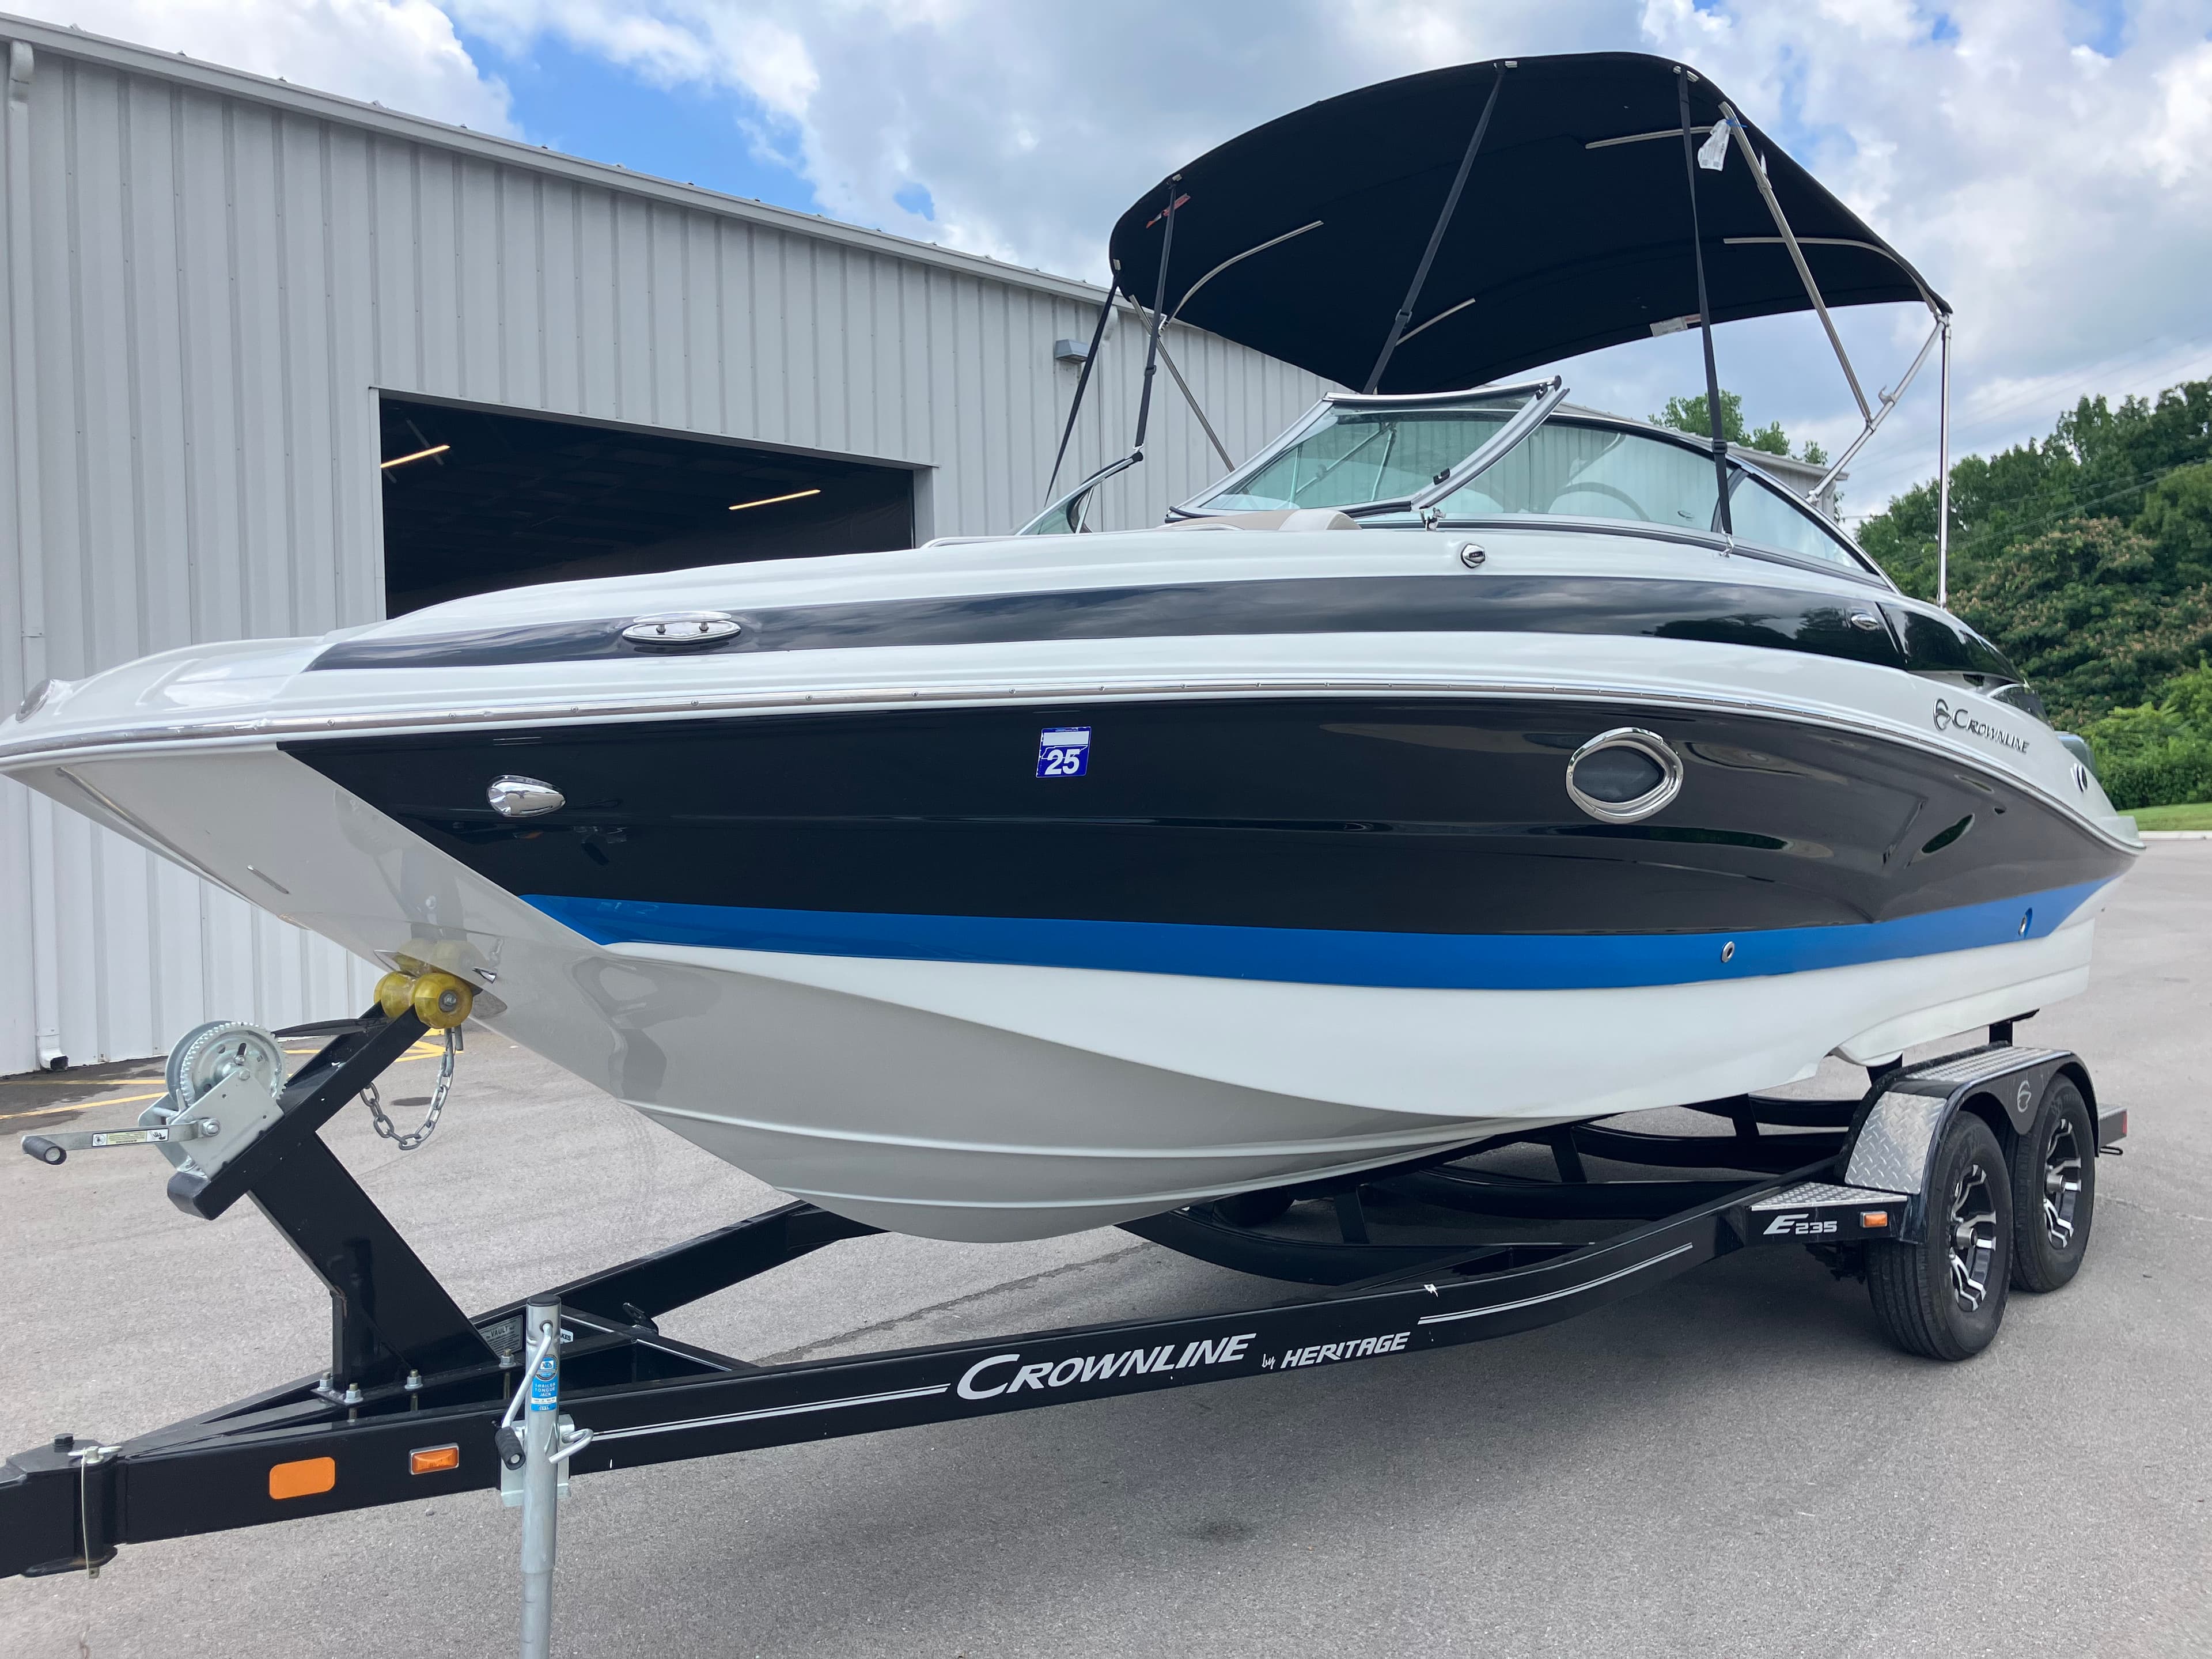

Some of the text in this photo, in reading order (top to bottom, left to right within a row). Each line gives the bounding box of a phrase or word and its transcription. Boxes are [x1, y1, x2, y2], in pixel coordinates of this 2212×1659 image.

[1952, 709, 2029, 753] CROWNLINE
[1044, 749, 1080, 775] 25
[491, 1325, 509, 1337] VAULT
[957, 1331, 1411, 1400] CROWNLINE by HERITAGE
